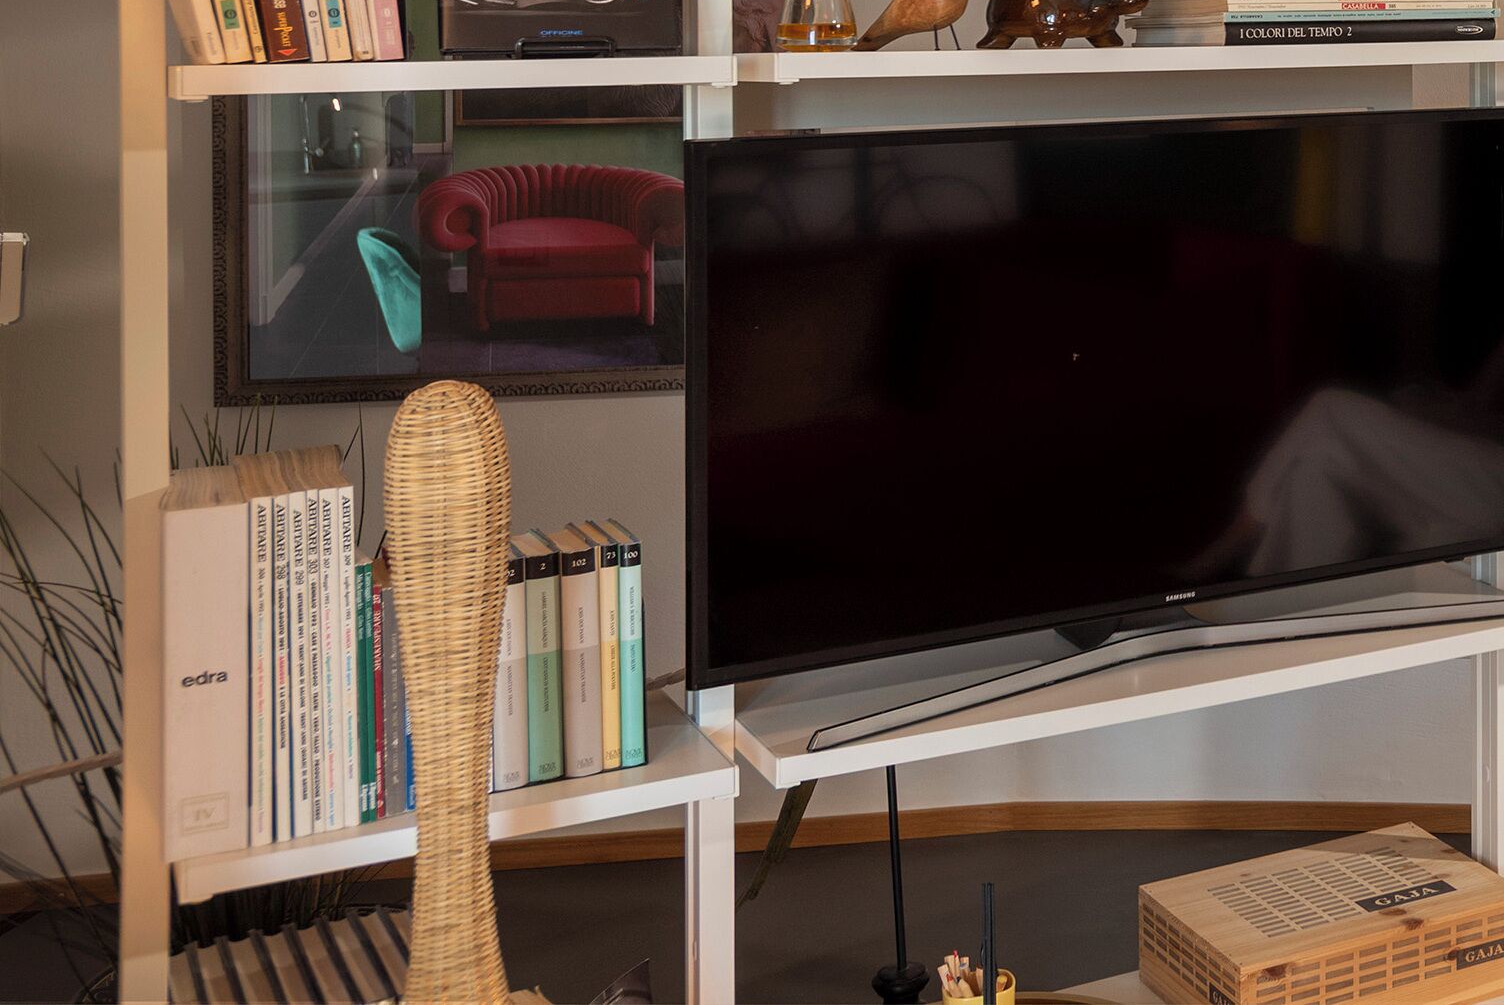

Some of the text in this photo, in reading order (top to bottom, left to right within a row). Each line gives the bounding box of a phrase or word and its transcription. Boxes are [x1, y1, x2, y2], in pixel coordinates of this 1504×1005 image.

[1240, 26, 1352, 38] I COLORI DEL TEMPO 2
[257, 504, 267, 563] ABITARE
[322, 498, 332, 556] ABITARE
[342, 495, 352, 553] ABITARE
[276, 504, 286, 580] ABITARE 298
[293, 509, 303, 567] ABITARE
[308, 498, 318, 575] ABITARE 303
[571, 558, 587, 568] 102
[605, 550, 616, 560] 73
[623, 550, 638, 559] 100
[540, 562, 547, 571] 2
[1165, 591, 1196, 602] SAMSUNG
[373, 610, 382, 672] SHAKESPEARE
[181, 668, 228, 689] edra
[1374, 884, 1443, 908] GAJA
[1464, 942, 1504, 964] GAJA
